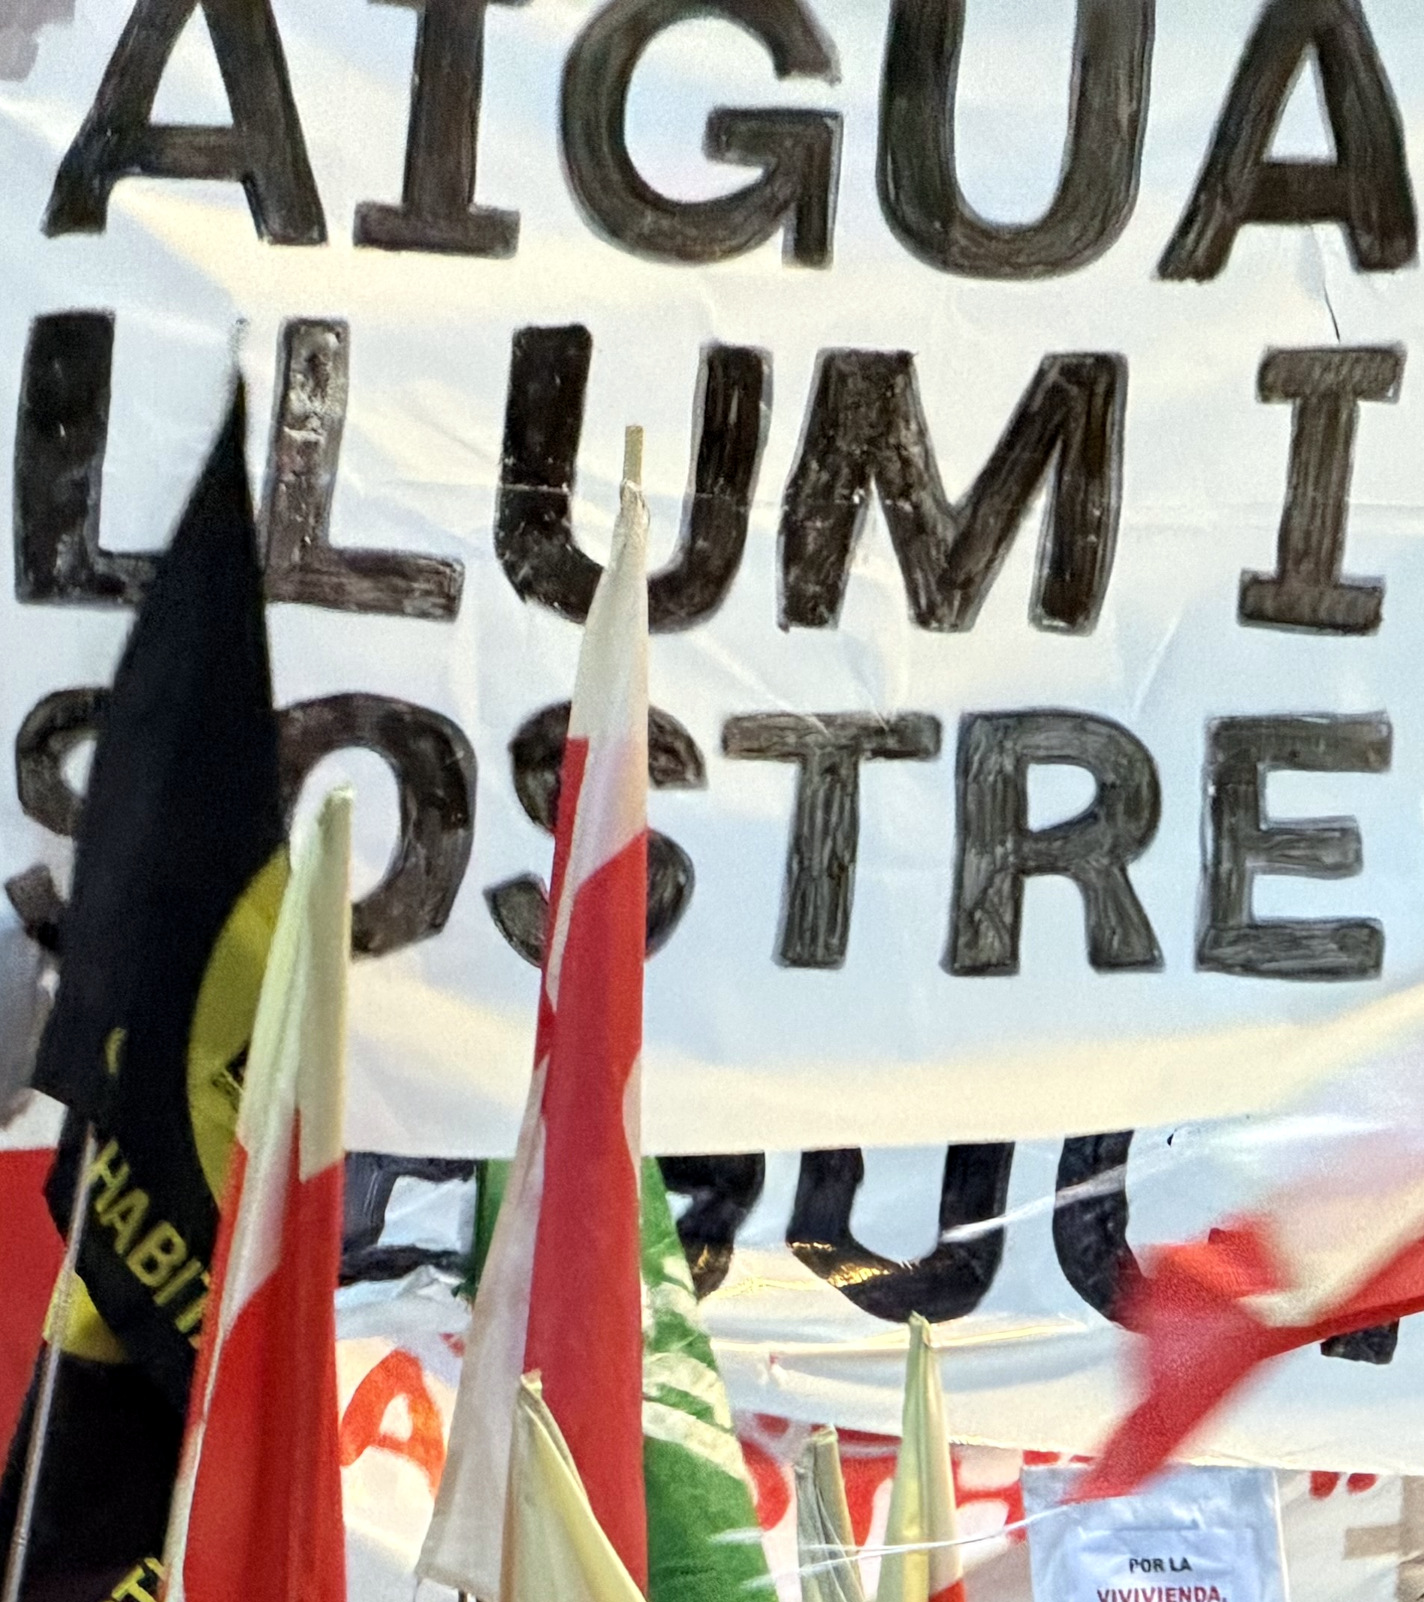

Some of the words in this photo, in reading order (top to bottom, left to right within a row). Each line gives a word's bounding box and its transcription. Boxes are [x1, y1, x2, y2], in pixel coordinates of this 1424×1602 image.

[41, 0, 1419, 283] AIGUA
[12, 308, 1128, 637] LLUM
[1237, 341, 1408, 636] I
[1129, 1557, 1165, 1574] POR
[1169, 1556, 1193, 1573] LA
